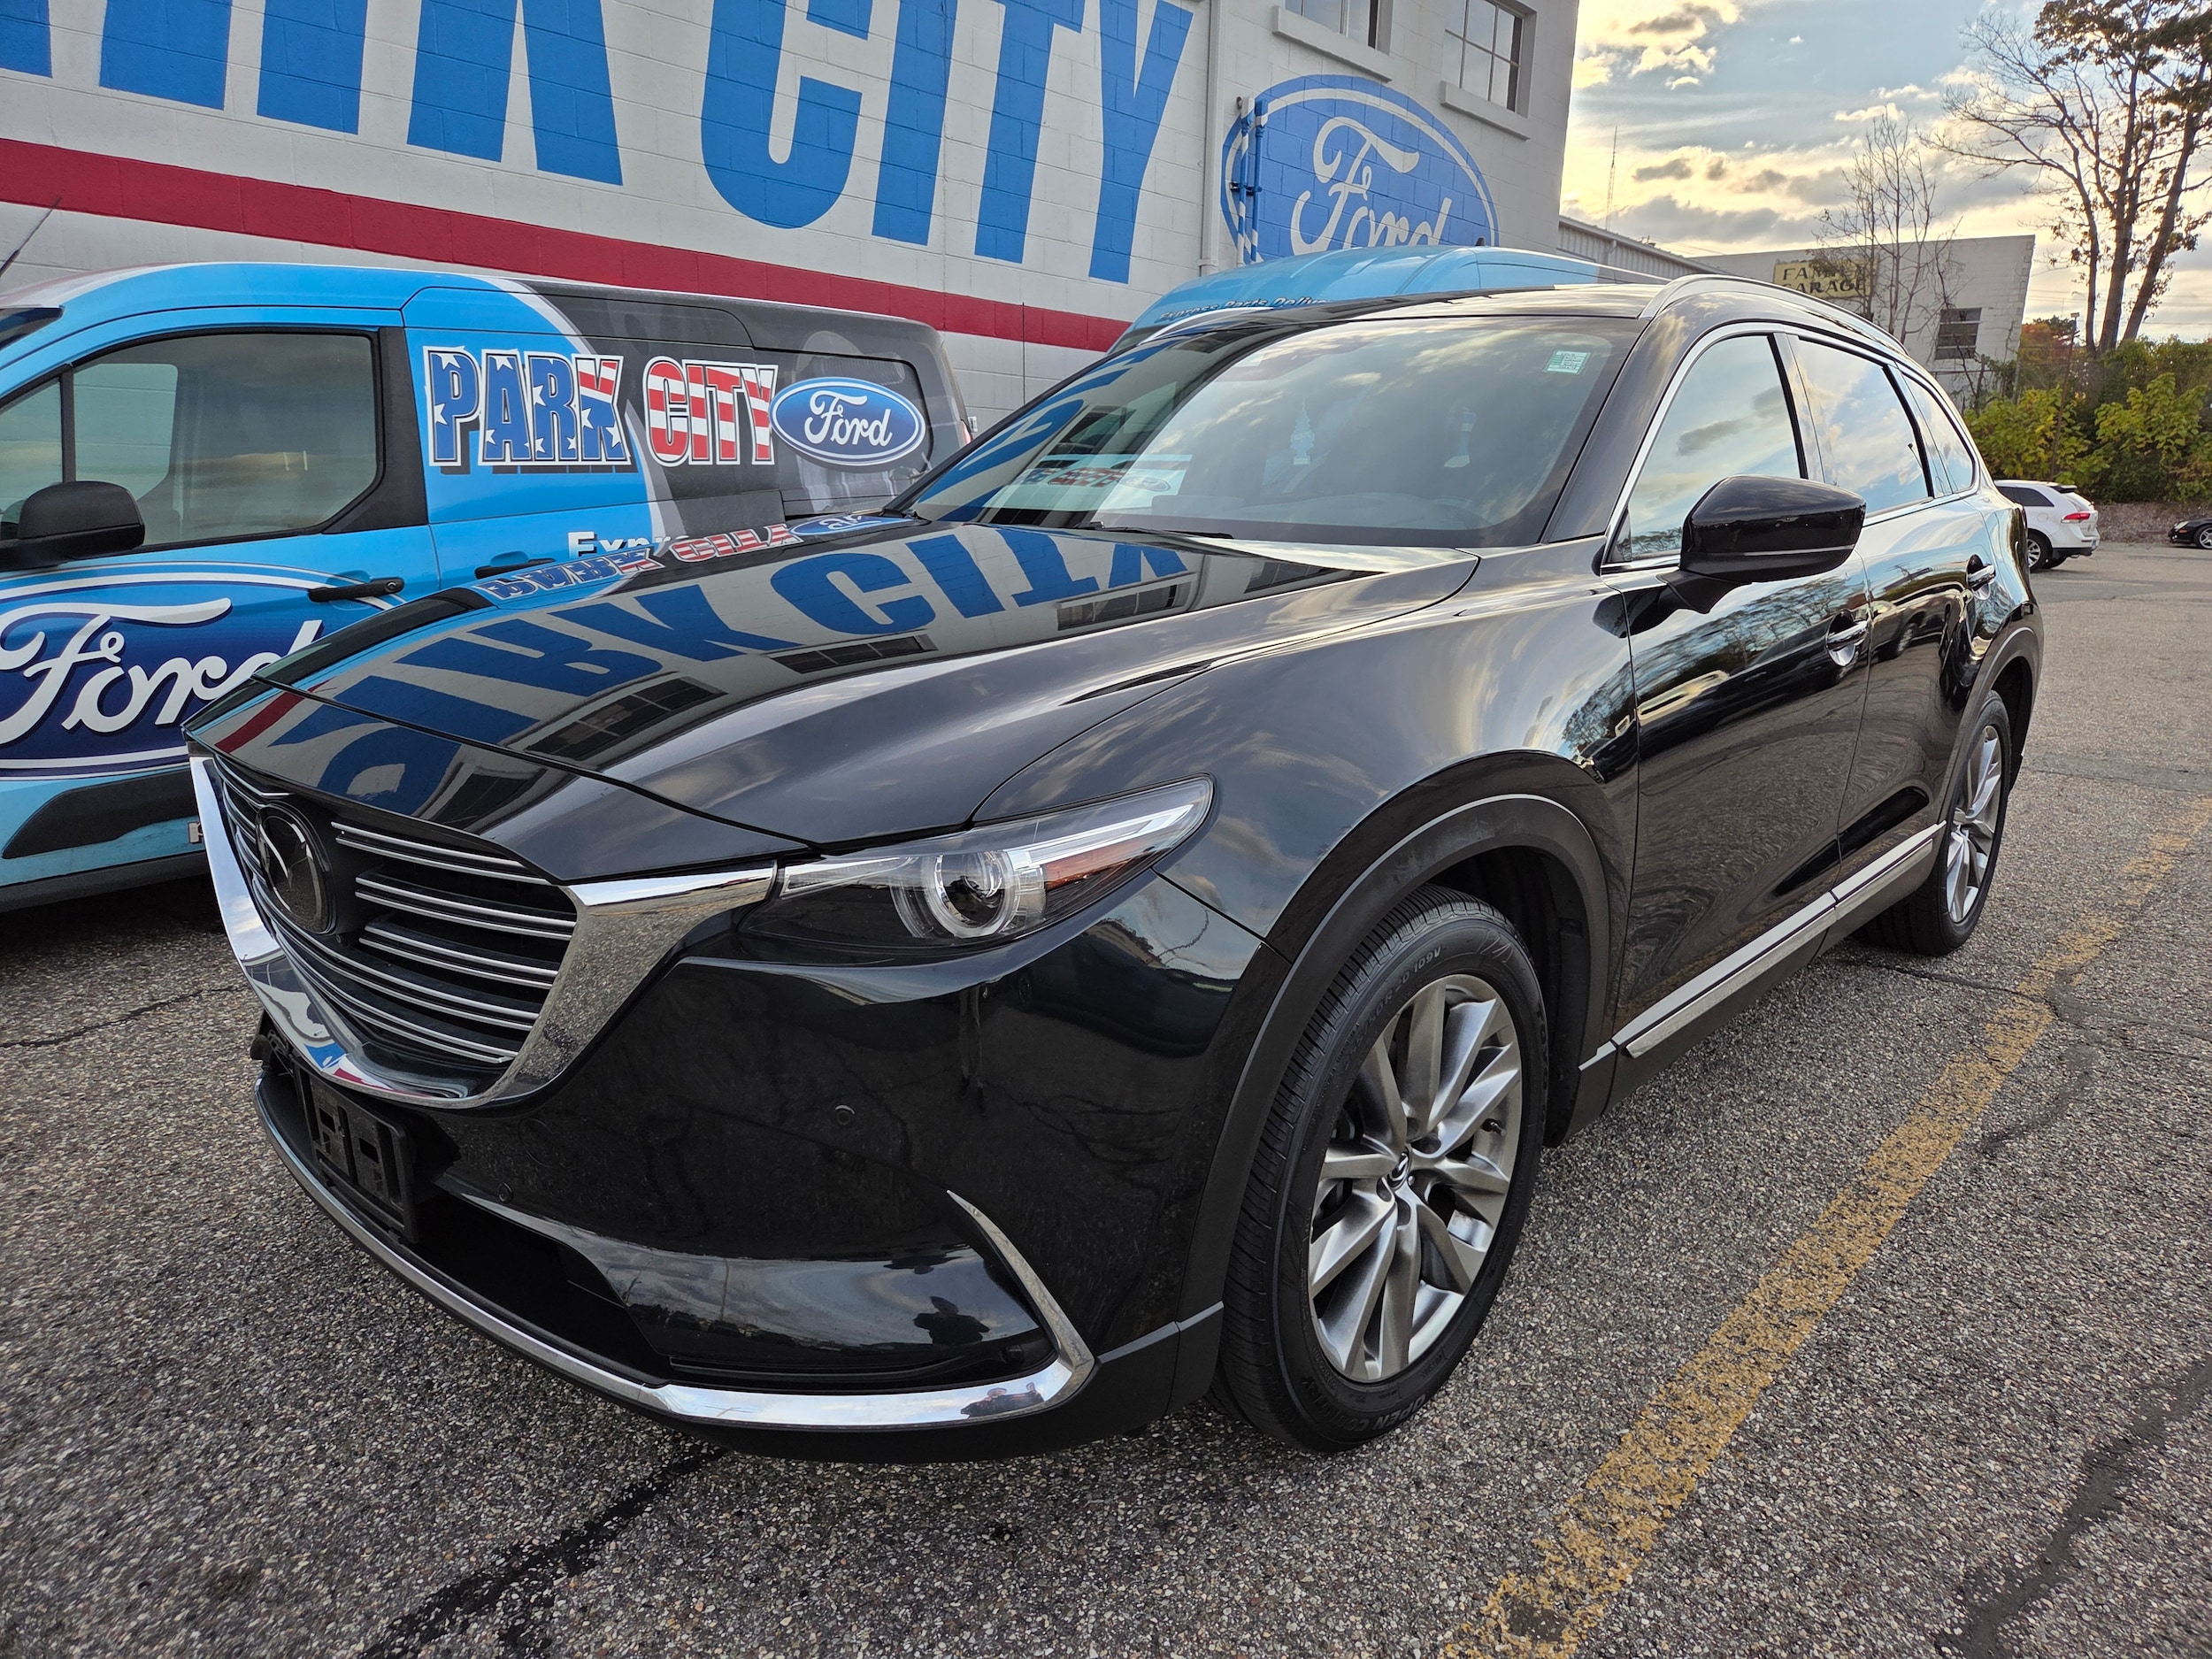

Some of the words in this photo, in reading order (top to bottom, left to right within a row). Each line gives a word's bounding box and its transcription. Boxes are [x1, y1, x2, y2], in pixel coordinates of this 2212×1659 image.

[702, 0, 1194, 285] CITY
[423, 346, 631, 466] PARK
[642, 356, 779, 467] CITY
[803, 389, 893, 448] Ford
